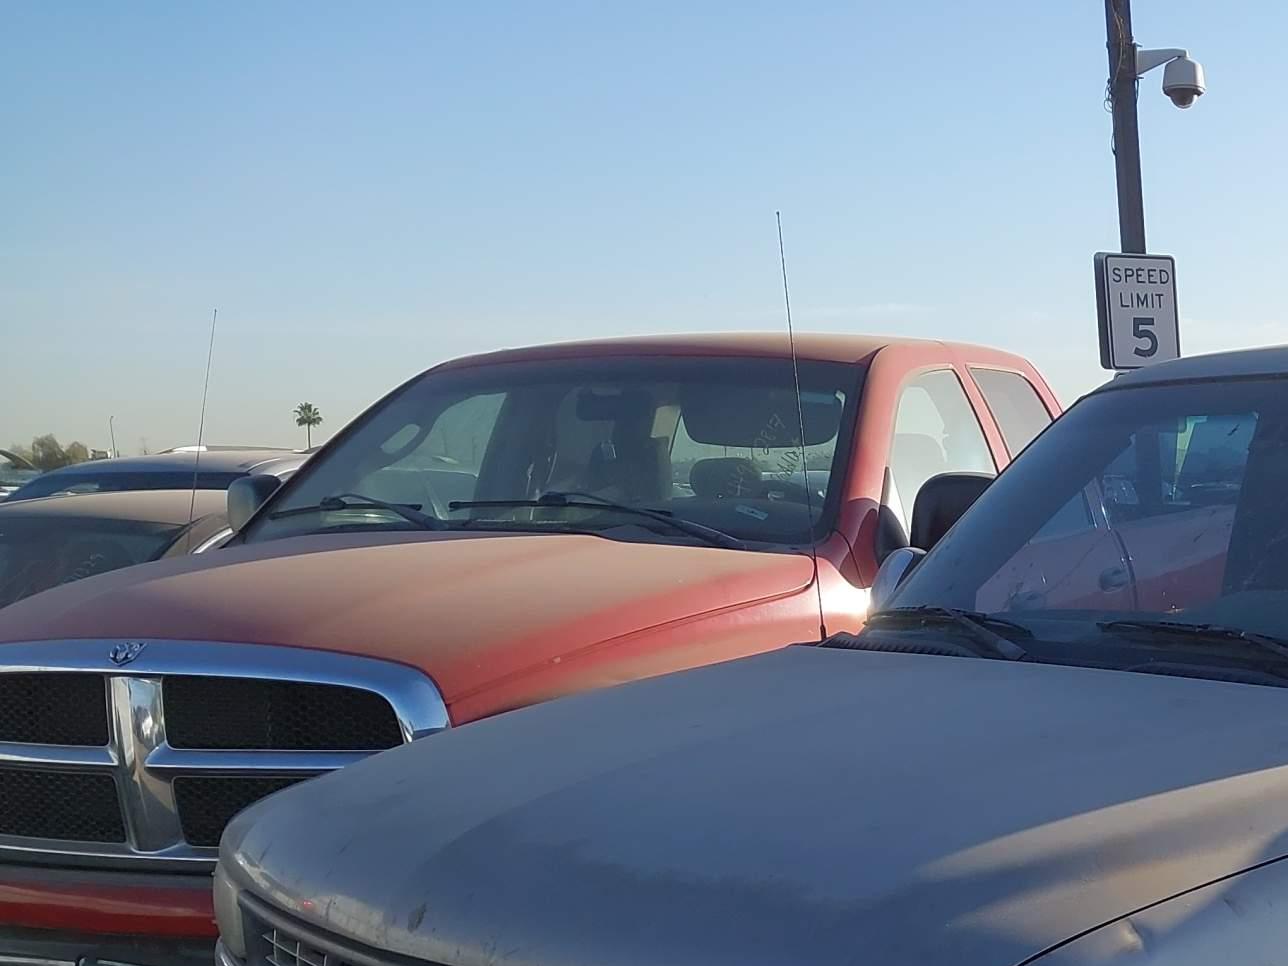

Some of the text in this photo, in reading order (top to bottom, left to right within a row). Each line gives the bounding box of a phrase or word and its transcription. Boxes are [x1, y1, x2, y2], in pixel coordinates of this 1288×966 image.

[1112, 267, 1170, 285] SPEED
[1119, 292, 1164, 309] LIMIT
[1132, 317, 1159, 358] 5
